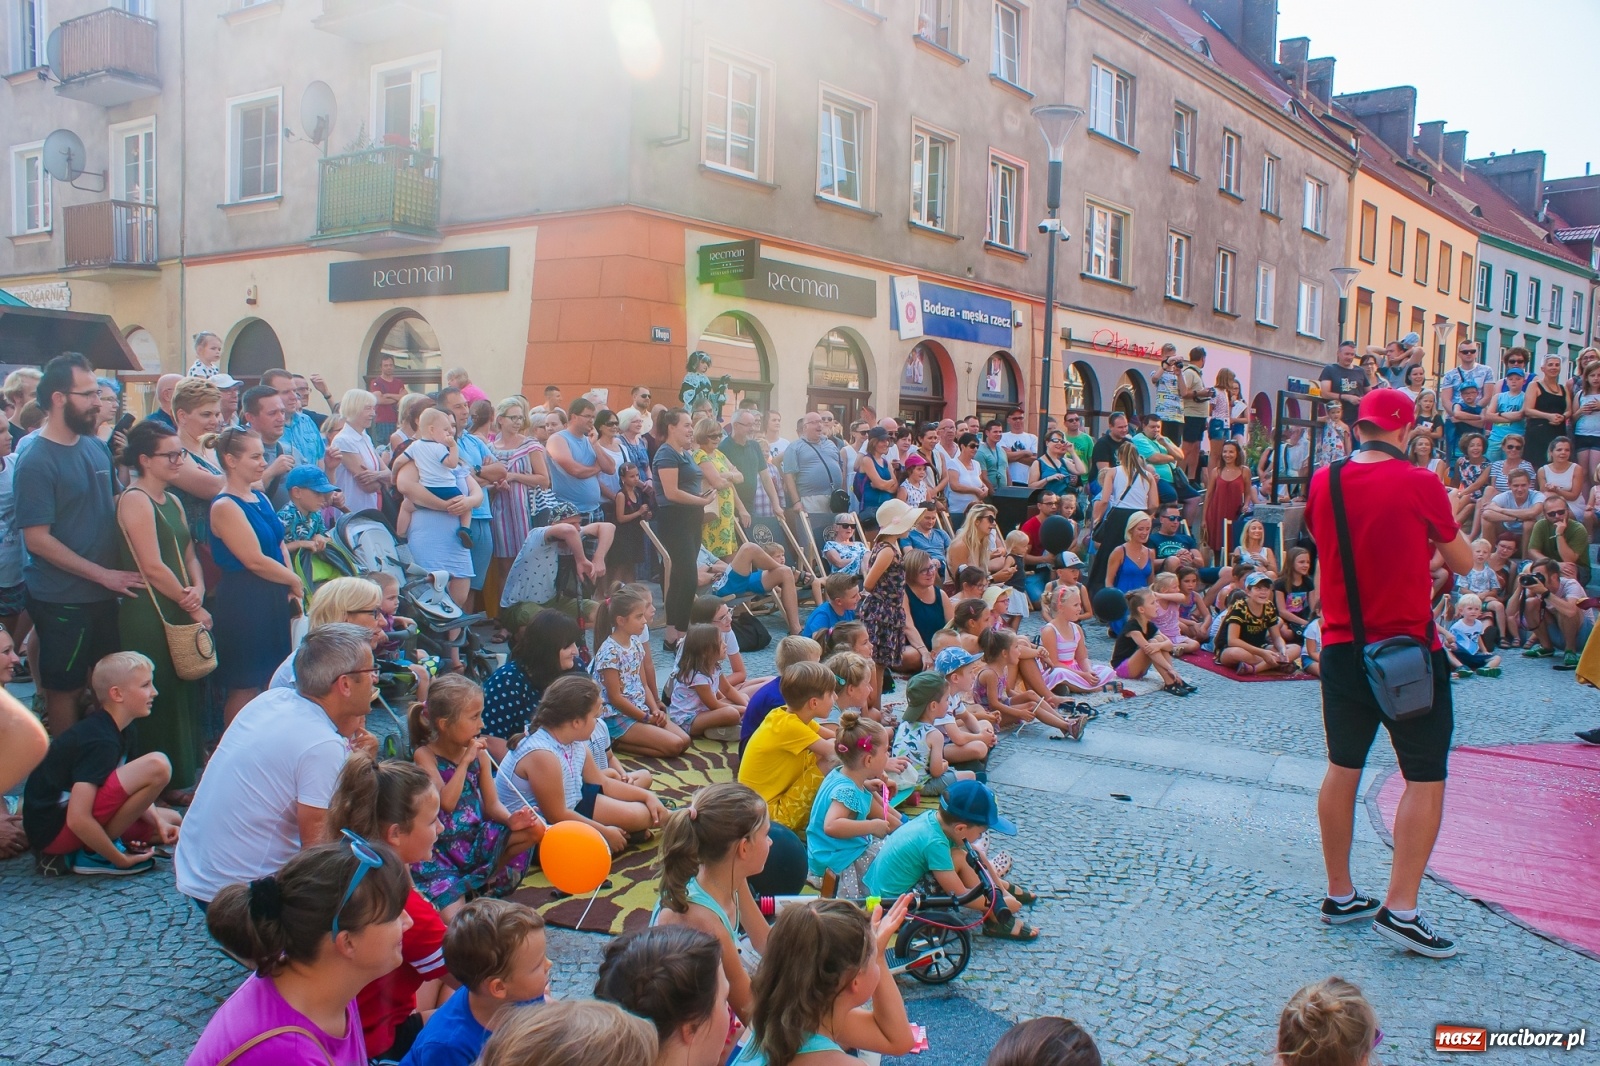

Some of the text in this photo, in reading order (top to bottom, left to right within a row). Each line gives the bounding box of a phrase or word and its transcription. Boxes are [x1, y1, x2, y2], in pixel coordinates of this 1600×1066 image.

[709, 248, 745, 261] Recman
[373, 264, 453, 288] Recman
[768, 271, 839, 300] Recman
[923, 299, 956, 318] Bodara
[962, 309, 989, 325] męska
[990, 315, 1011, 328] rzecz
